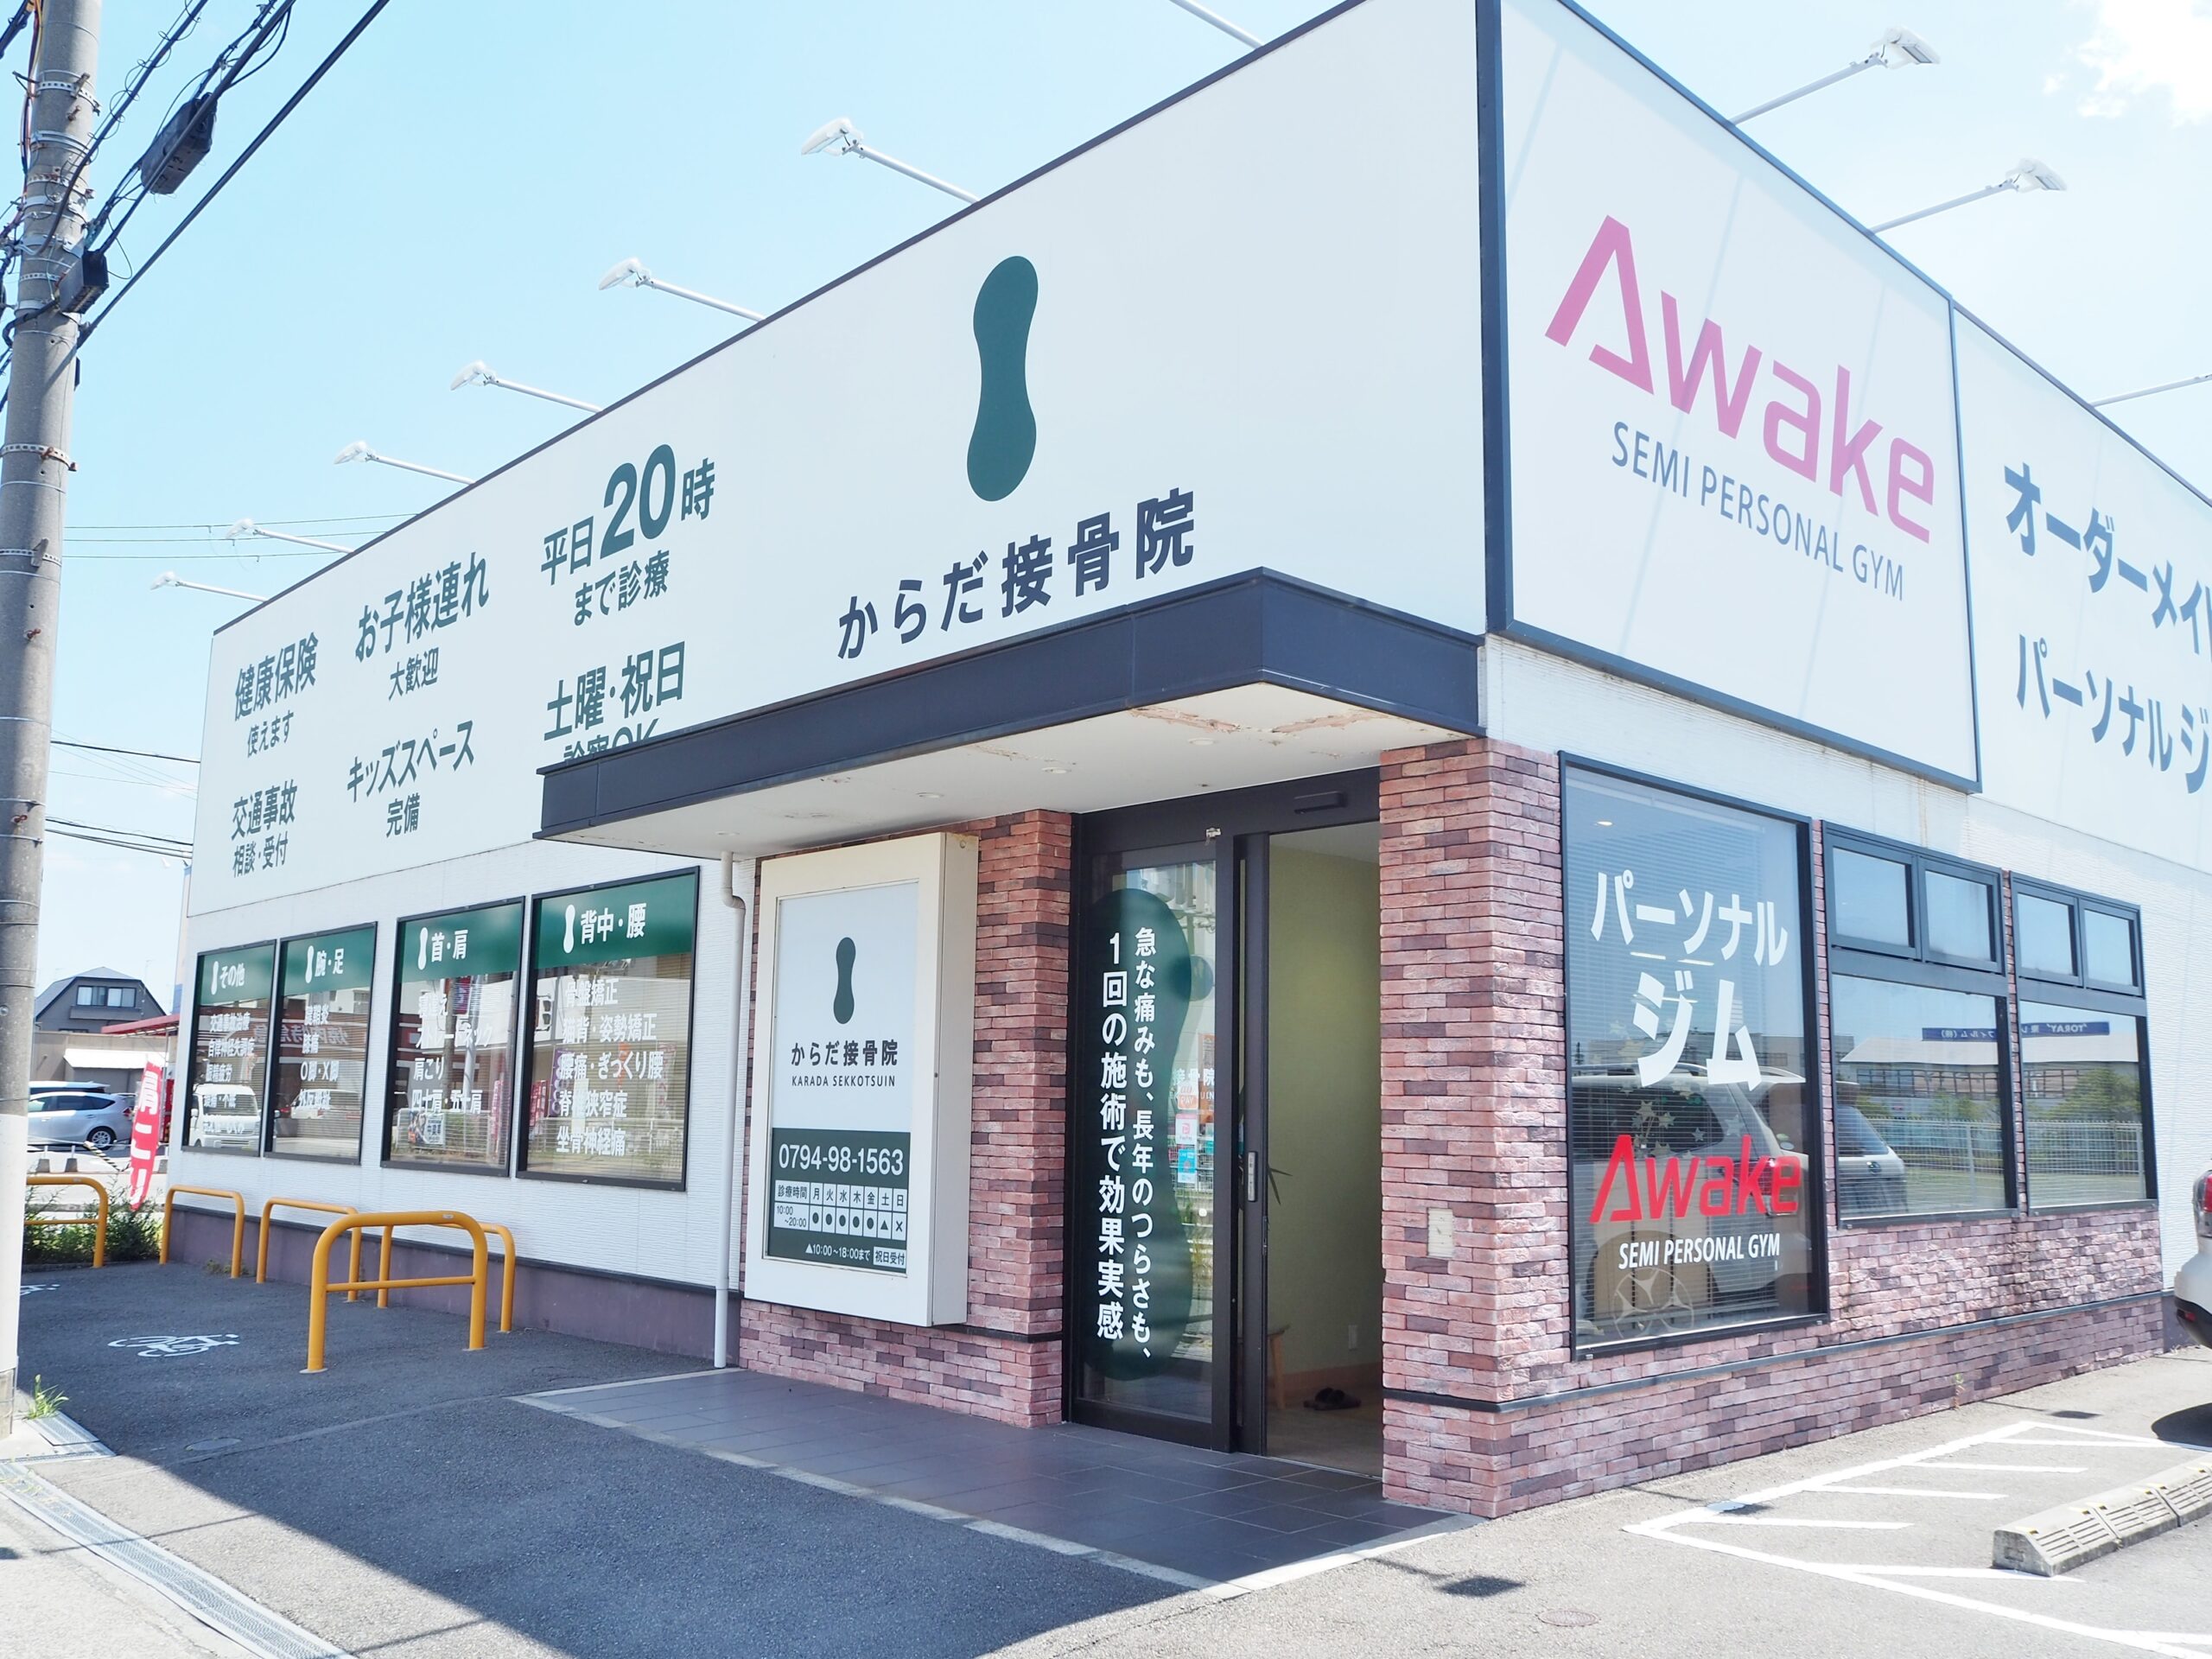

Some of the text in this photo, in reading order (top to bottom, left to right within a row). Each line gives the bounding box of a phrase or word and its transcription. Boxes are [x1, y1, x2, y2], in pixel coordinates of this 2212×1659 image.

[1545, 214, 1935, 544] Awake
[541, 444, 715, 585] 平日20時
[1611, 421, 1903, 601] SEMI PERSONAL GYM
[574, 550, 671, 626] まで診療
[837, 487, 1194, 660] からだ接骨院
[355, 551, 489, 662] お子様連れ
[234, 632, 318, 721] 健康保険
[389, 646, 439, 701] 大歓迎
[544, 641, 685, 741] 土曜・祝日
[247, 709, 294, 758] 使えます
[347, 720, 474, 802] キッズスペース
[232, 779, 297, 841] 交通事故
[385, 793, 421, 837] 完備
[232, 830, 288, 878] 相談・受付
[581, 903, 646, 944] 背中・腰
[1591, 869, 1788, 967] パーソナル
[315, 948, 344, 977] 腕・足
[431, 930, 468, 963] 首・肩
[219, 963, 245, 988] その他
[565, 978, 620, 1007] 骨盤矯正
[562, 1013, 657, 1044] 猫背・姿勢矯正
[1632, 969, 1764, 1092] ジム
[413, 1057, 444, 1081] 肩こり
[560, 1051, 664, 1080] 腰痛・ぎっくり腰
[791, 1039, 899, 1067] からだ接骨院
[411, 1089, 483, 1114] 四十肩・五十肩
[791, 1075, 896, 1088] KARADA SEKKOTSUIN
[556, 1125, 626, 1157] 坐骨神経痛
[779, 1143, 905, 1175] 0794-98-1563
[1096, 932, 1128, 1340] 1回の施術で効果実感
[1131, 926, 1157, 1360] 急な痛みも、長年のつらさも、
[778, 1185, 904, 1207] 診療時間 月 火 水 木 金 土 日
[1590, 1134, 1802, 1224] Awake
[777, 1205, 793, 1216] 10:00
[874, 1250, 906, 1266] 祝日受付
[1618, 1233, 1781, 1269] SEMI PERSONAL GYM
